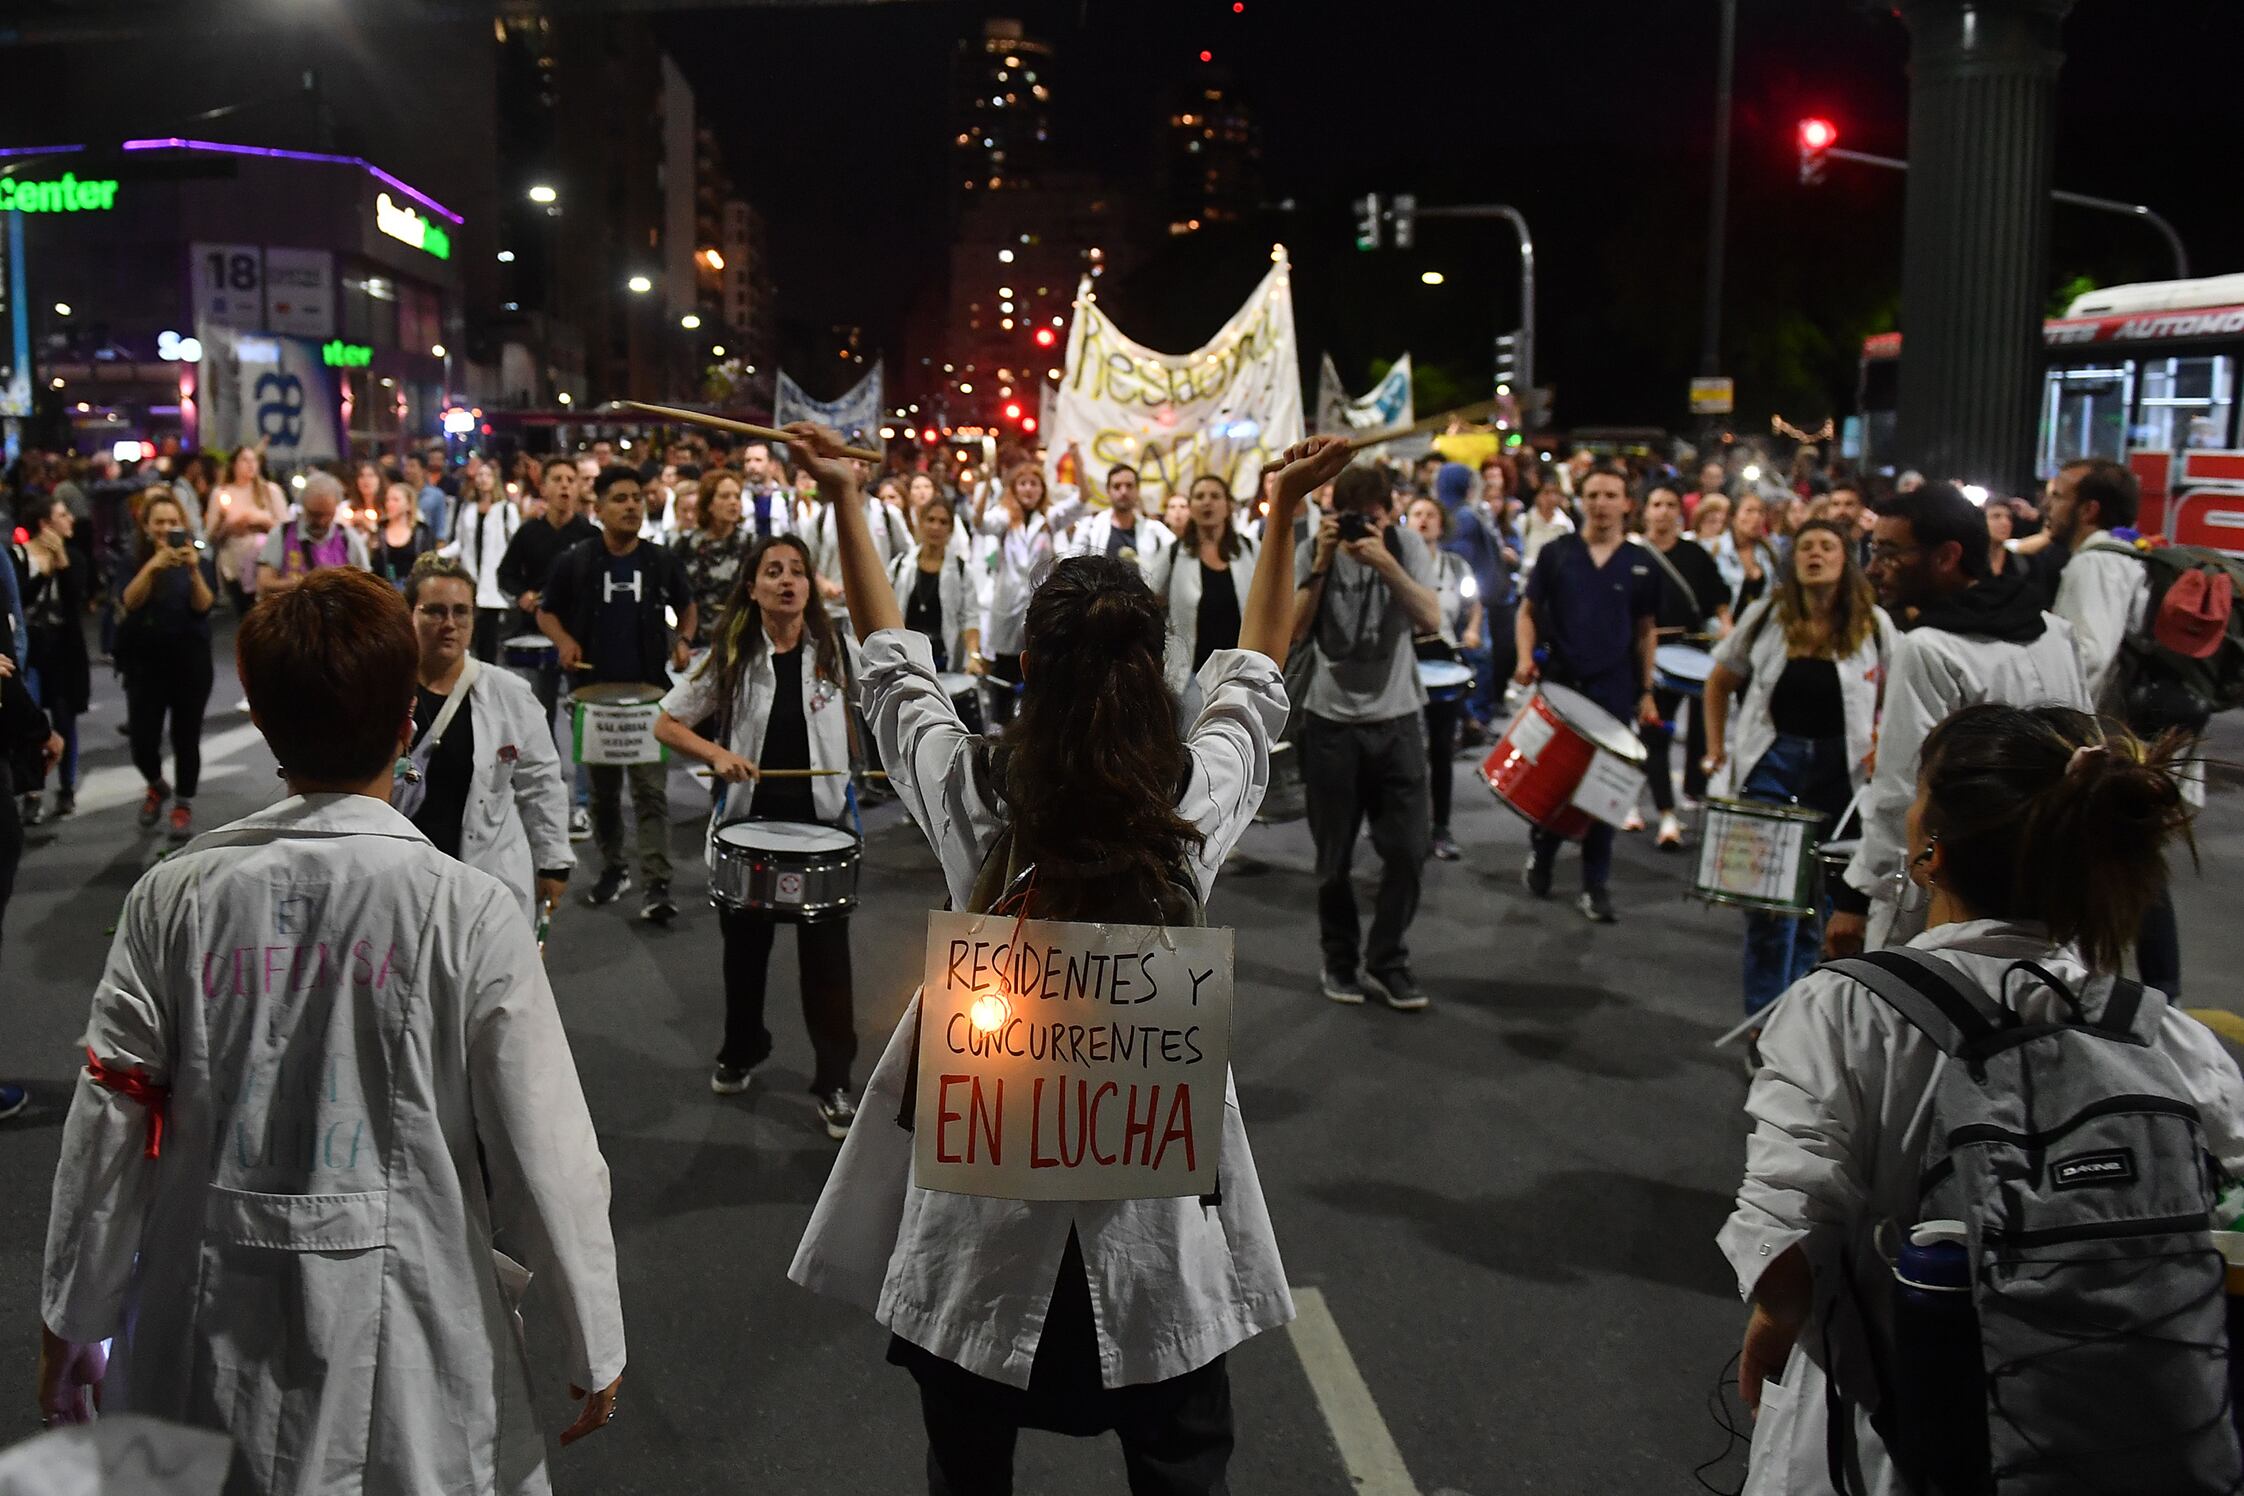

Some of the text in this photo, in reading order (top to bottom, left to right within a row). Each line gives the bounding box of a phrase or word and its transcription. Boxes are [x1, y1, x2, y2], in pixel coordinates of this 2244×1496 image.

[206, 252, 256, 291] 18
[603, 570, 642, 604] H
[947, 939, 1214, 1006] RESIDENTES Y
[946, 1013, 1204, 1069] CONCURRENTES
[936, 1074, 1197, 1172] EN LUCHA
